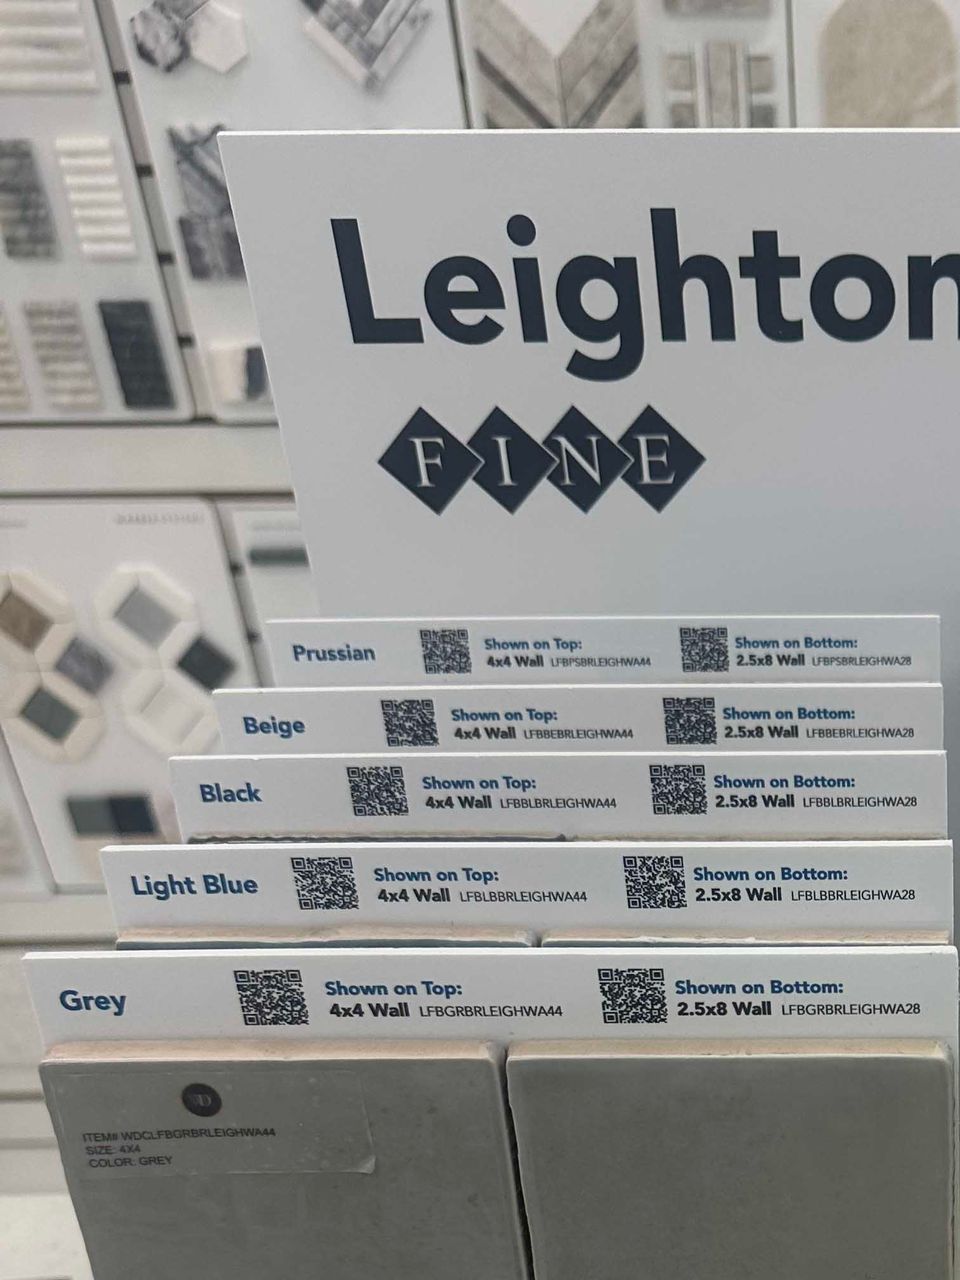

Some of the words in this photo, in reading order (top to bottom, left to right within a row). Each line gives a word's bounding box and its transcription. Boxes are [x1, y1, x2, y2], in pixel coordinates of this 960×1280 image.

[407, 436, 680, 488] FINE
[484, 638, 529, 650] Shown
[533, 641, 550, 649] on
[553, 638, 582, 652] Top:
[735, 636, 779, 648] Shown
[784, 640, 800, 648] on
[804, 637, 857, 648] Bottom:
[293, 644, 375, 661] Prussian
[487, 656, 511, 667] 4x4
[514, 655, 544, 667] Wall
[737, 654, 773, 666] 2.5x8
[776, 654, 805, 666] Wall
[451, 709, 500, 721] Shown
[504, 712, 523, 721] on
[526, 708, 557, 724] Top:
[723, 707, 771, 720] Shown
[775, 711, 793, 719] on
[798, 707, 855, 719] Bottom:
[243, 716, 305, 738] Beige
[454, 727, 481, 739] 4x4
[484, 726, 516, 739] Wall
[524, 729, 633, 739] LFBBEBRLEIGHWA44
[725, 726, 764, 738] 2.5x8
[768, 725, 798, 738] Wall
[806, 728, 914, 738] LFBBEBRLEIGHWA28
[422, 776, 475, 789] Shown
[479, 780, 499, 789] on
[502, 776, 536, 792] Top:
[714, 775, 765, 788] Shown
[770, 779, 788, 788] on
[794, 775, 855, 788] Bottom:
[200, 783, 262, 802] Black
[426, 796, 454, 808] 4x4
[457, 795, 492, 808] Wall
[500, 798, 616, 808] LFBBLBRLEIGHWA44
[716, 795, 757, 808] 2.5x8
[762, 794, 794, 807] Wall
[803, 797, 917, 807] LFBBLBRLEIGHWA28
[374, 867, 431, 881] Shown
[436, 872, 458, 881] on
[462, 868, 499, 885] Top:
[694, 867, 749, 881] Shown
[755, 871, 775, 880] on
[781, 867, 847, 880] Bottom:
[131, 874, 197, 900] Light
[203, 873, 258, 894] Blue
[378, 889, 409, 902] 4x4
[413, 888, 450, 902] Wall
[460, 891, 587, 902] LFBLBBRLEIGHWA44
[696, 888, 741, 901] 2.5x8
[746, 887, 782, 901] Wall
[792, 890, 915, 901] LFBLBBRLEIGHWA28
[325, 981, 388, 995] Shown
[394, 985, 417, 995] on
[421, 981, 462, 999] Top:
[675, 980, 736, 994] Shown
[742, 984, 764, 994] on
[771, 980, 843, 994] Bottom:
[59, 990, 126, 1016] Grey
[330, 1003, 364, 1017] 4x4
[368, 1002, 410, 1017] Wall
[419, 1006, 562, 1017] LFBGRBRLEIGHWA44
[678, 1002, 727, 1016] 2.5x8
[732, 1001, 771, 1015] Wall
[782, 1003, 920, 1015] LFBGRBRLEIGHWA28
[89, 1158, 136, 1168] COLOR:
[139, 1156, 172, 1165] GREY
